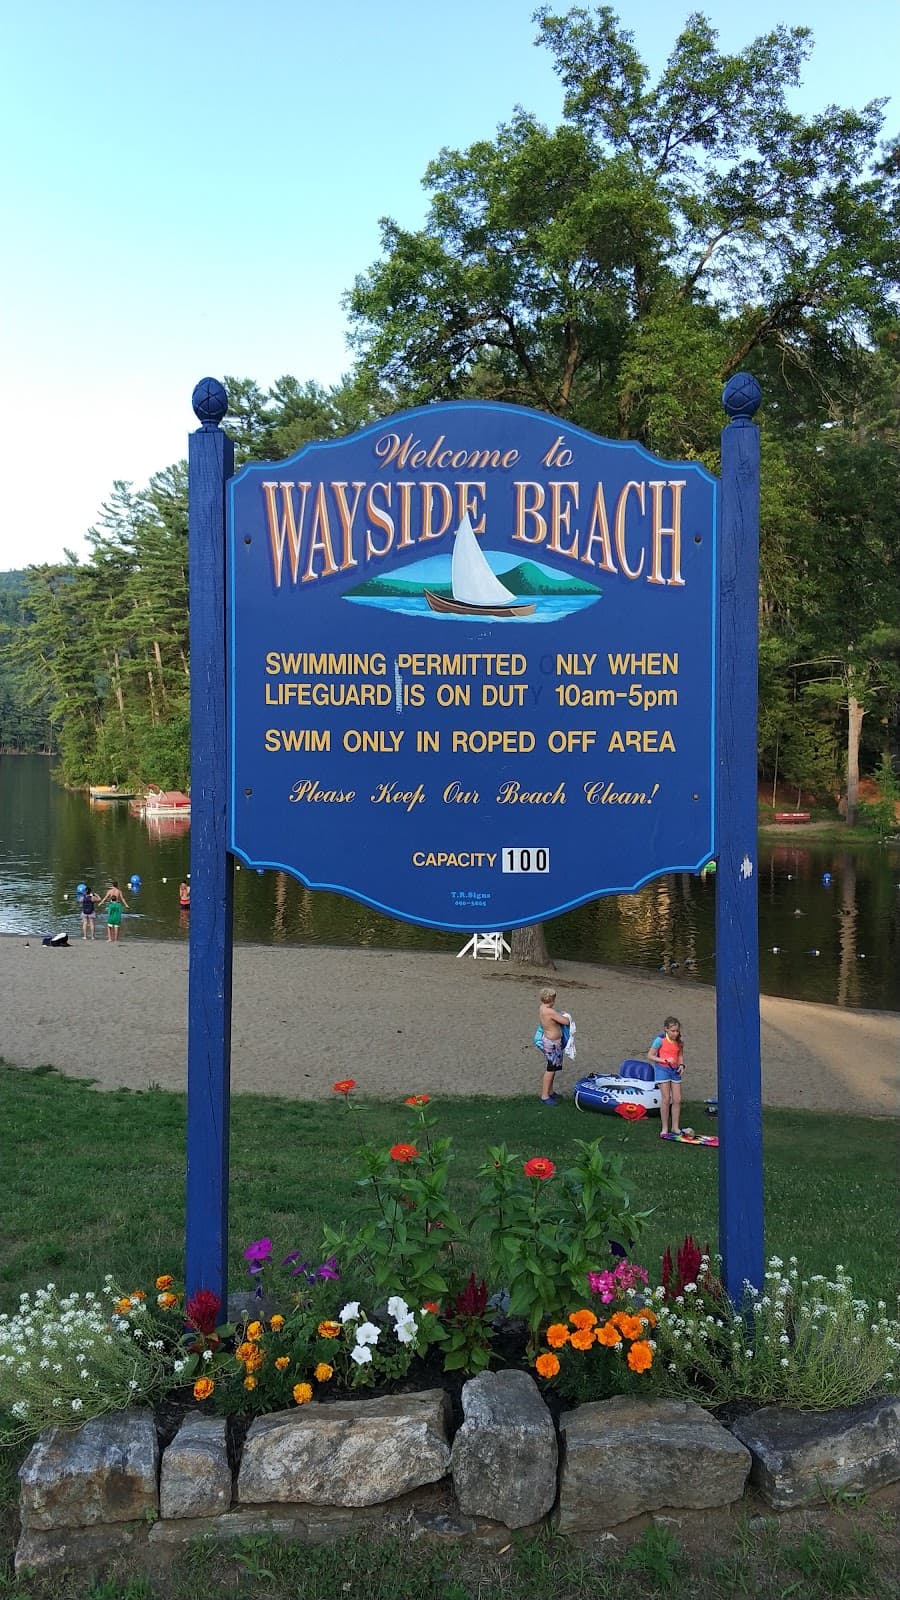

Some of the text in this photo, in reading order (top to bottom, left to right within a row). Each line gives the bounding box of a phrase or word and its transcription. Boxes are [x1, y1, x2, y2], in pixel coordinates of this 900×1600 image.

[374, 432, 574, 470] Welcome to
[261, 480, 687, 589] WAYSIDE BEACH
[265, 652, 387, 675] SWIMMING
[398, 653, 527, 676] PERMITTED
[608, 653, 679, 675] WHEN
[265, 684, 392, 706] LIFEGUARD
[404, 684, 425, 706] IS
[436, 684, 471, 706] ON
[555, 684, 678, 711] 10am-5pm
[264, 729, 676, 753] SWIM ONLY IN ROPED OFF AREA
[289, 779, 660, 812] Please Keep Our Beach Clean!
[412, 849, 547, 872] CAPACITY 100
